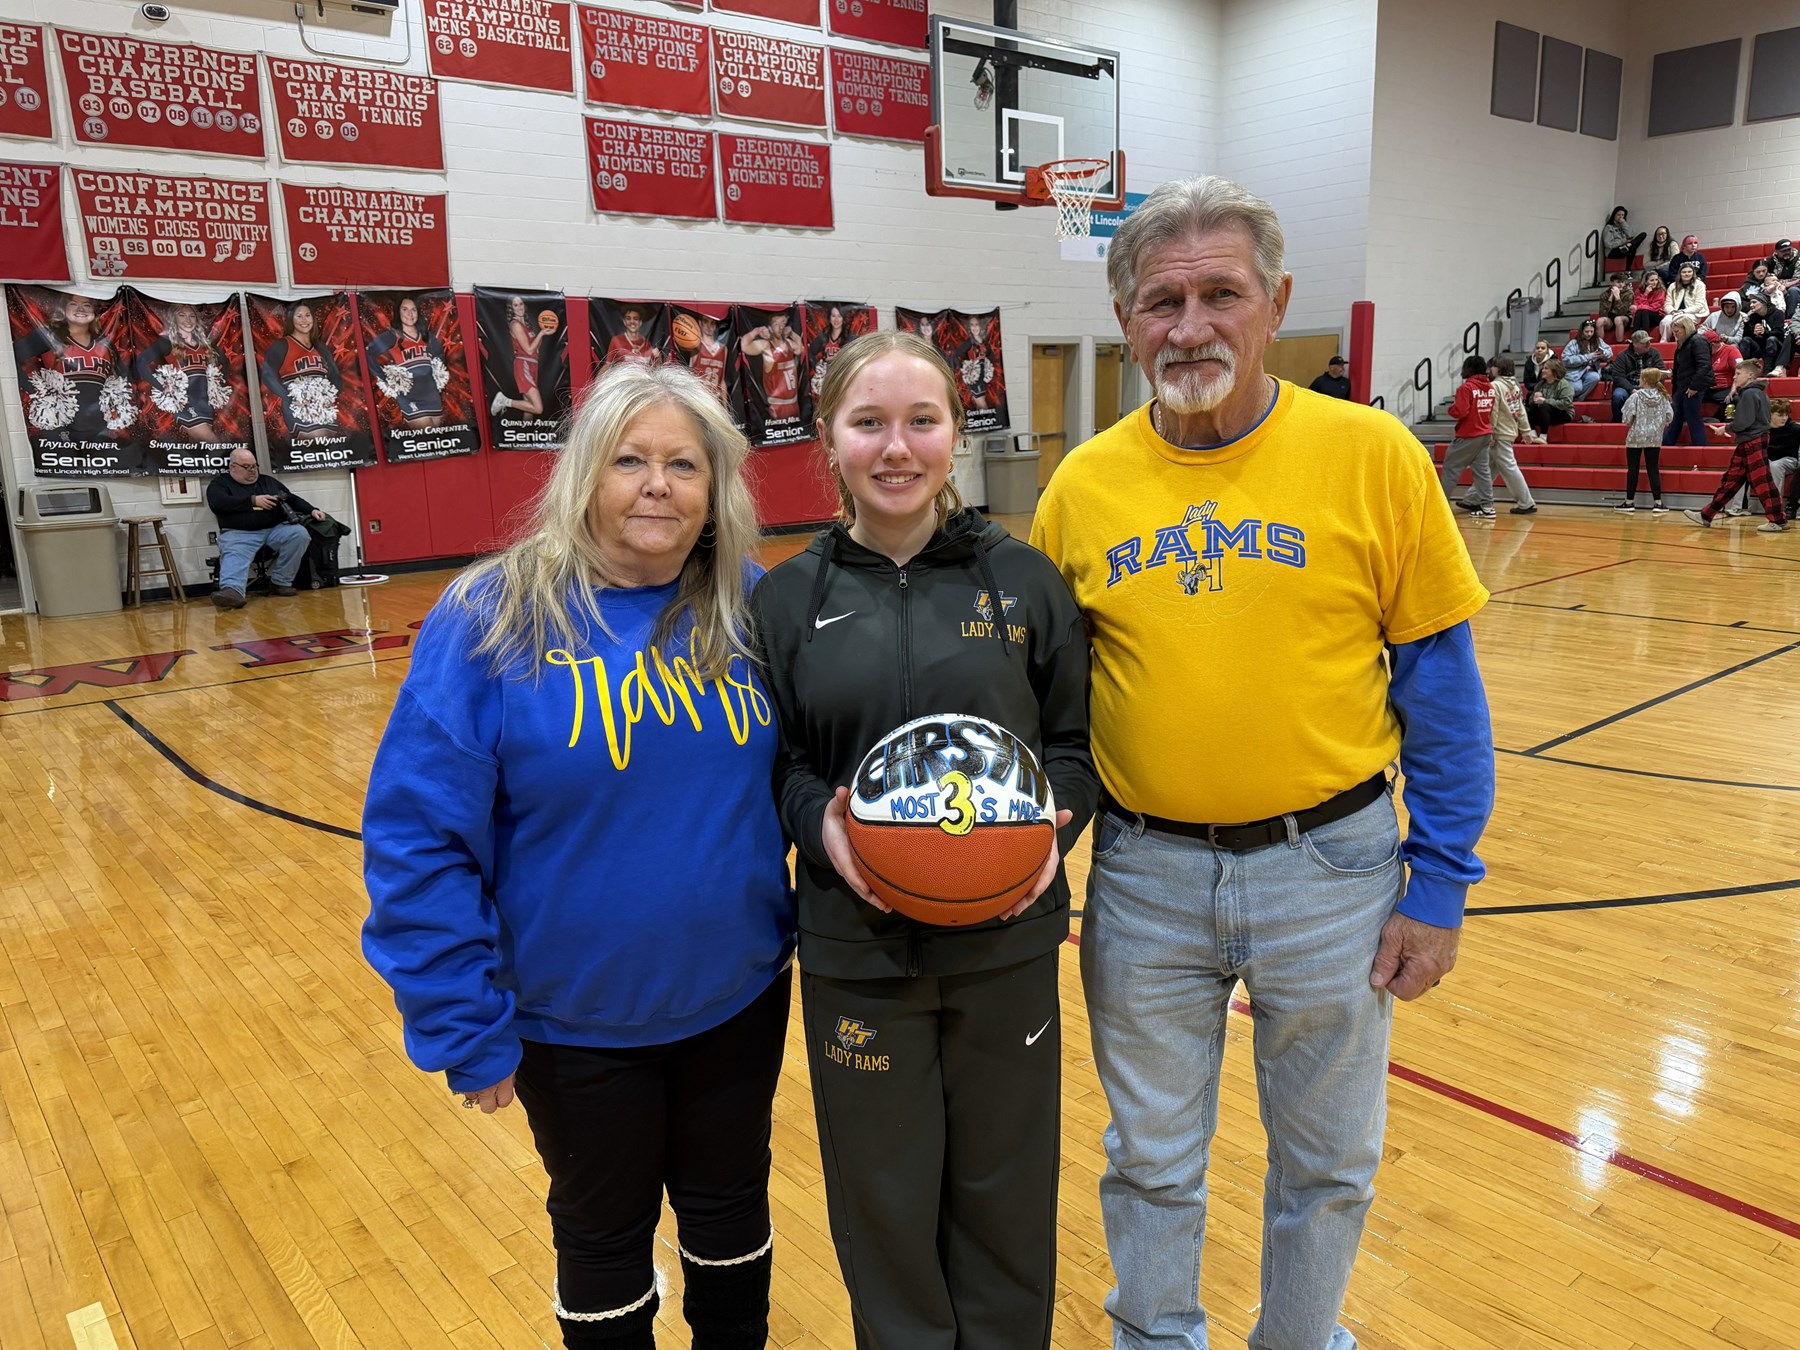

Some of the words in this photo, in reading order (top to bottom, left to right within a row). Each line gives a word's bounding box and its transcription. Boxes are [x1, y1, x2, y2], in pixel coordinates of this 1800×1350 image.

[436, 2, 561, 35] CHAMPIONS
[586, 10, 703, 43] CONFERENCE
[428, 16, 471, 37] MENS
[476, 23, 570, 52] BASKETBALL
[437, 39, 452, 50] 62
[461, 43, 475, 53] 82
[595, 28, 697, 58] CHAMPIONS
[716, 31, 821, 61] TOURNAMENT
[62, 33, 254, 75] CONFERENCE
[595, 43, 648, 66] MEN'S
[655, 53, 699, 73] GOLF
[723, 48, 817, 75] CHAMPIONS
[834, 52, 927, 79] TOURNAMENT
[78, 55, 245, 92] CHAMPIONS
[272, 61, 436, 95] CONFERENCE
[593, 63, 603, 75] 17
[716, 61, 824, 90] VOLLEYBALL
[842, 68, 921, 92] CHAMPIONS
[20, 93, 35, 105] 10
[86, 75, 242, 110] BASEBALL
[286, 81, 428, 111] CHAMPIONS
[739, 84, 750, 93] 99
[836, 81, 884, 100] WOMENS
[889, 89, 928, 106] TENNIS
[82, 100, 101, 112] 83
[112, 102, 130, 114] 00
[140, 106, 157, 119] 07
[169, 110, 186, 122] 08
[196, 112, 208, 124] 11
[219, 115, 234, 127] 13
[242, 117, 257, 129] 16
[296, 100, 346, 120] MENS
[358, 105, 423, 127] TENNIS
[88, 122, 104, 134] 19
[289, 122, 306, 134] 78
[317, 125, 332, 136] 87
[342, 126, 357, 137] 08
[593, 122, 707, 148] CONFERENCE
[602, 139, 702, 163] CHAMPIONS
[735, 138, 814, 160] REGIONAL
[597, 154, 665, 175] WOMEN'S
[671, 162, 707, 179] GOLF
[732, 153, 820, 175] CHAMPIONS
[77, 173, 265, 203] CONFERENCE
[599, 175, 609, 186] 19
[615, 177, 625, 187] 21
[728, 168, 788, 186] WOMEN'S
[792, 173, 825, 189] GOLF
[305, 189, 425, 212] TOURNAMENT
[729, 187, 739, 198] 21
[94, 196, 257, 222] CHAMPIONS
[299, 207, 435, 229] CHAMPIONS
[85, 215, 149, 236] WOMENS
[154, 220, 200, 238] CROSS
[205, 222, 269, 242] COUNTRY
[326, 225, 413, 245] TENNIS
[99, 240, 115, 251] 91
[127, 242, 145, 252] 96
[156, 243, 174, 254] 00
[184, 243, 202, 254] 04
[216, 243, 230, 255] 05
[241, 243, 252, 255] 06
[300, 247, 316, 258] 79
[104, 260, 115, 270] 16
[766, 427, 804, 439] Senior
[967, 417, 997, 428] Senior
[403, 437, 461, 453] Senior
[504, 430, 557, 442] Senior
[41, 453, 118, 467] Senior
[290, 448, 354, 464] Senior
[435, 450, 449, 458] High
[450, 447, 471, 455] School
[301, 462, 324, 470] Lincoln
[1181, 500, 1218, 527] Lady
[1106, 519, 1306, 589] RAMS
[961, 622, 994, 638] LADY
[890, 793, 939, 820] MOST
[1008, 799, 1041, 823] MADE
[825, 1041, 852, 1067] LADY
[855, 1053, 890, 1071] RAMS
